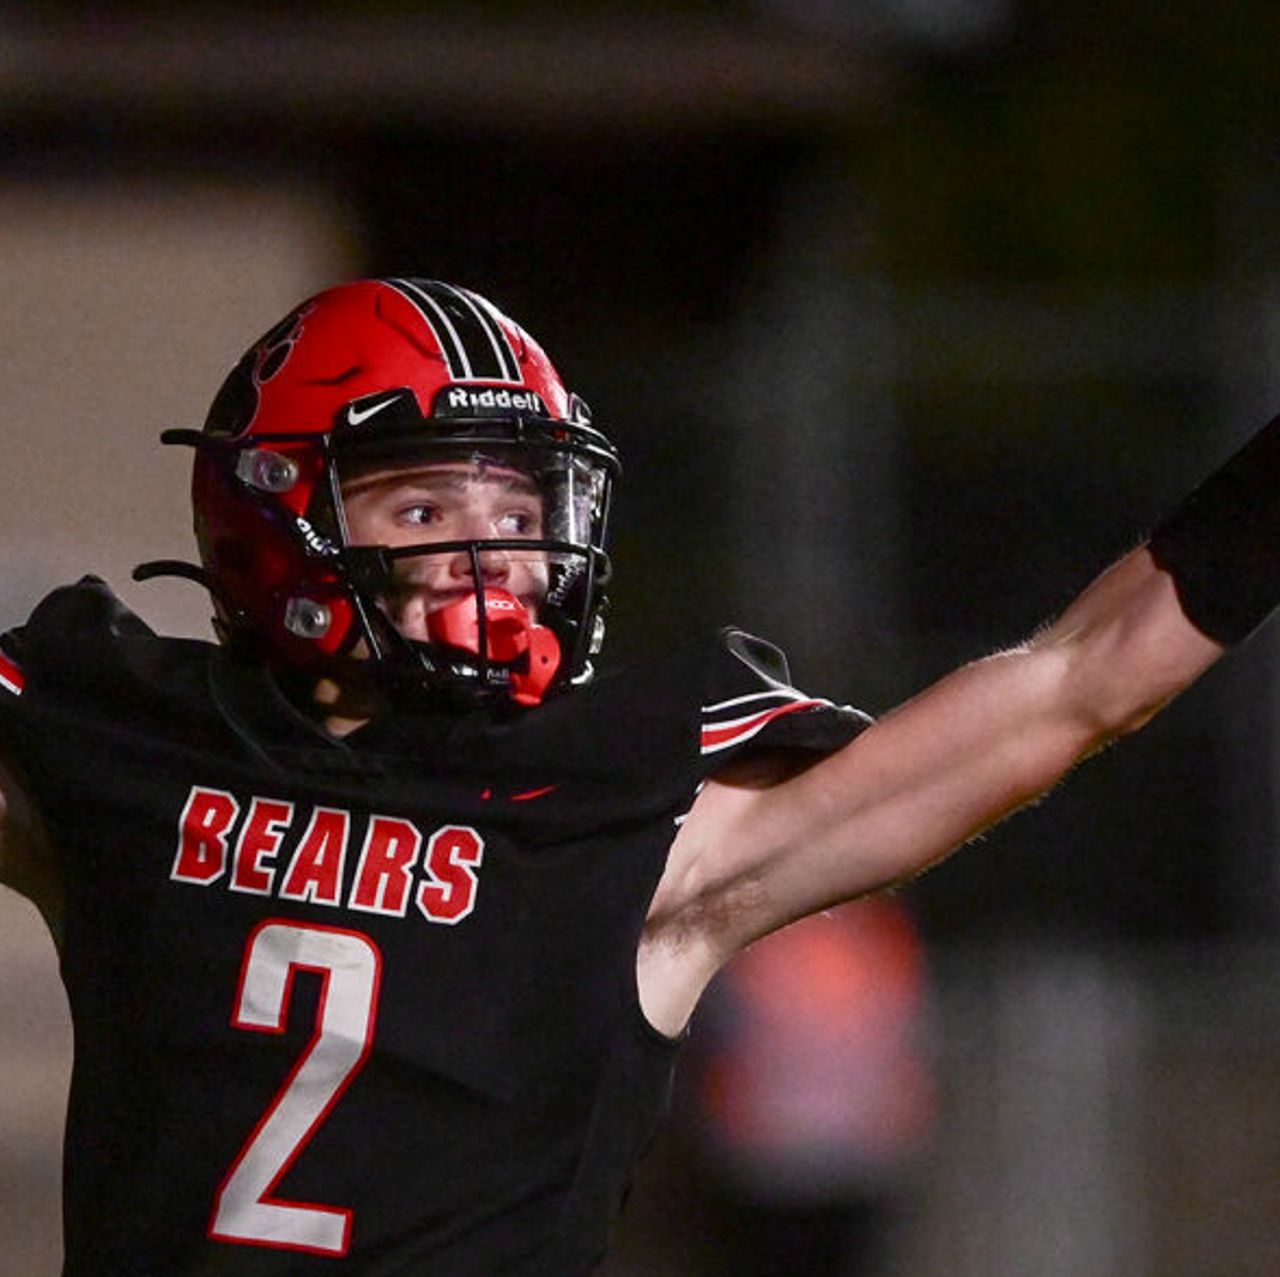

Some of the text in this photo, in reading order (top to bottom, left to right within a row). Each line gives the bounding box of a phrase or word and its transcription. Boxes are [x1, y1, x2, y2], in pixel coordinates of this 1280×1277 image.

[448, 387, 540, 413] Riddell
[170, 785, 485, 925] BEARS
[207, 916, 384, 1258] 2
